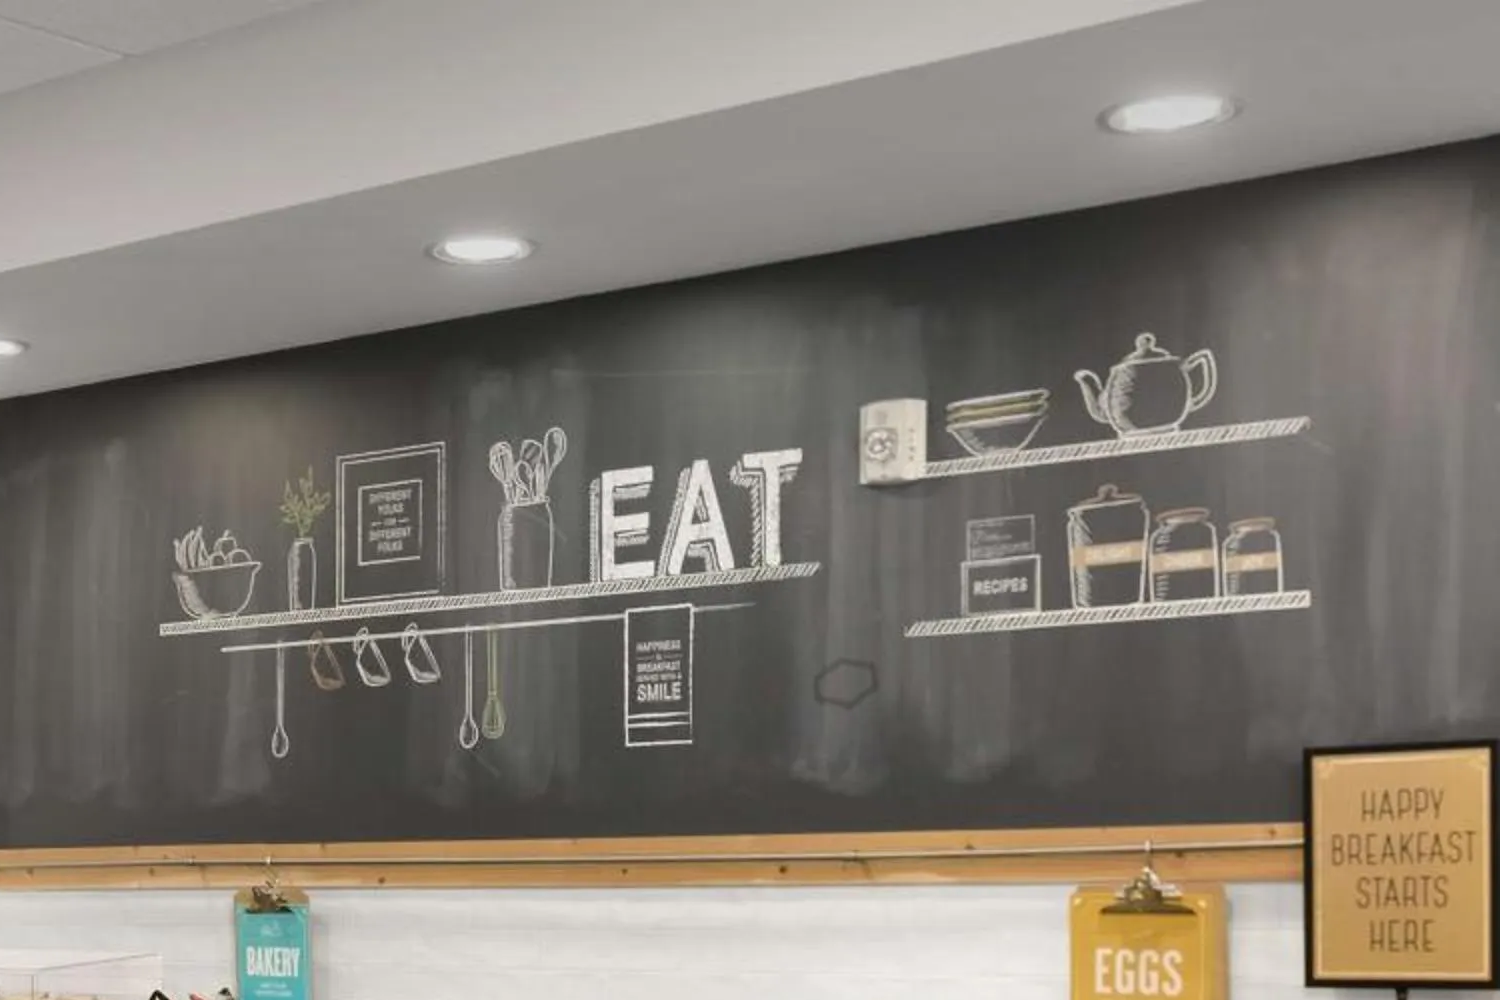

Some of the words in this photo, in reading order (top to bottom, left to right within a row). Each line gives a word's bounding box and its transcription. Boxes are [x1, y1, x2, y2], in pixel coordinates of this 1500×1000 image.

[589, 448, 803, 580] EAT
[973, 577, 1028, 595] RECIPES
[637, 682, 683, 701] SMILE
[1361, 788, 1445, 822] HAPPY
[1331, 830, 1477, 867] BREAKFAST
[1355, 875, 1450, 910] STARTS
[1369, 918, 1436, 953] HERE
[246, 946, 300, 977] BAKERY
[1095, 948, 1183, 996] EGGS
